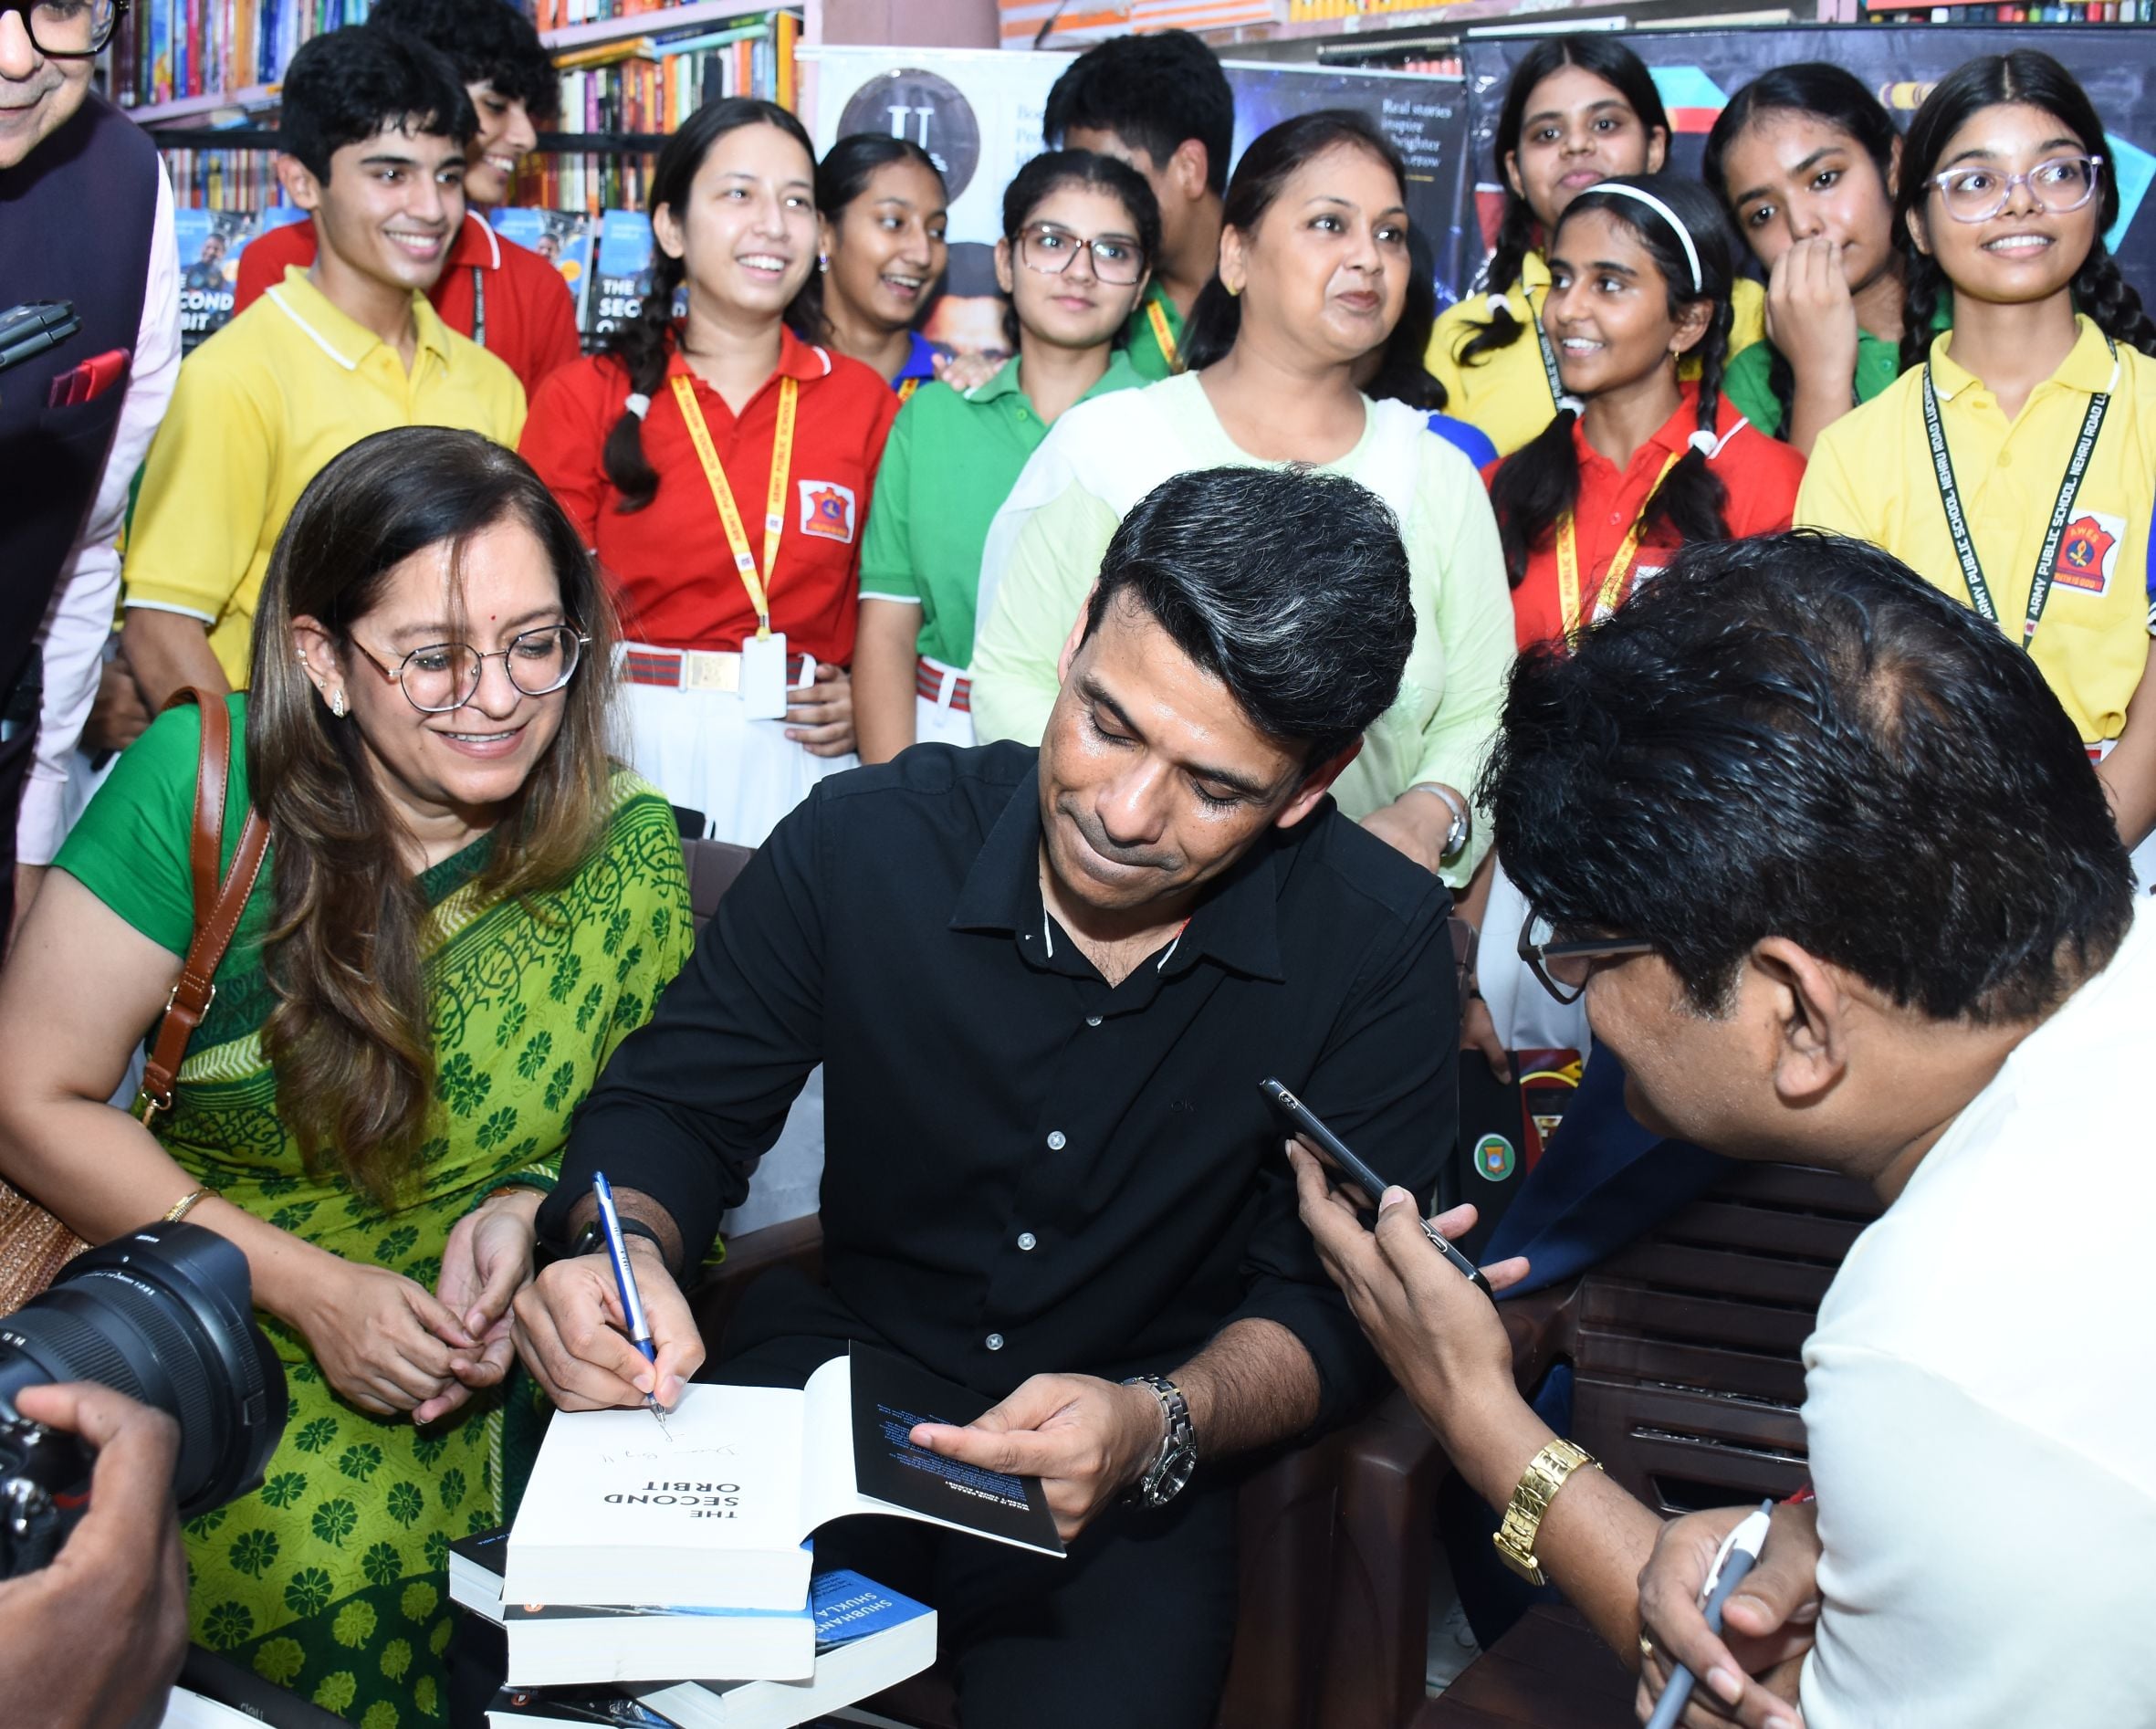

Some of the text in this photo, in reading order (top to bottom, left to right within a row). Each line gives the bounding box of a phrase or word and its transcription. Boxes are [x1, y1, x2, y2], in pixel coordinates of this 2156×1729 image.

[180, 290, 235, 311] COND
[602, 278, 635, 296] THE
[1928, 421, 1945, 453] ROAD
[2083, 404, 2103, 437] ROAD
[1934, 451, 1953, 491] NEHRU
[2068, 436, 2093, 477] NEHRU
[1956, 537, 1982, 585] PUBLIC
[2037, 529, 2061, 577] PUBLIC
[1972, 586, 1994, 620] ARMY
[2028, 577, 2047, 616] ARMY
[603, 1493, 740, 1507] SECOND
[642, 1481, 741, 1494] ORBIT
[689, 1509, 738, 1520] THE
[815, 1592, 878, 1618] SHUKLA
[815, 1599, 893, 1634] SHUBHANS
